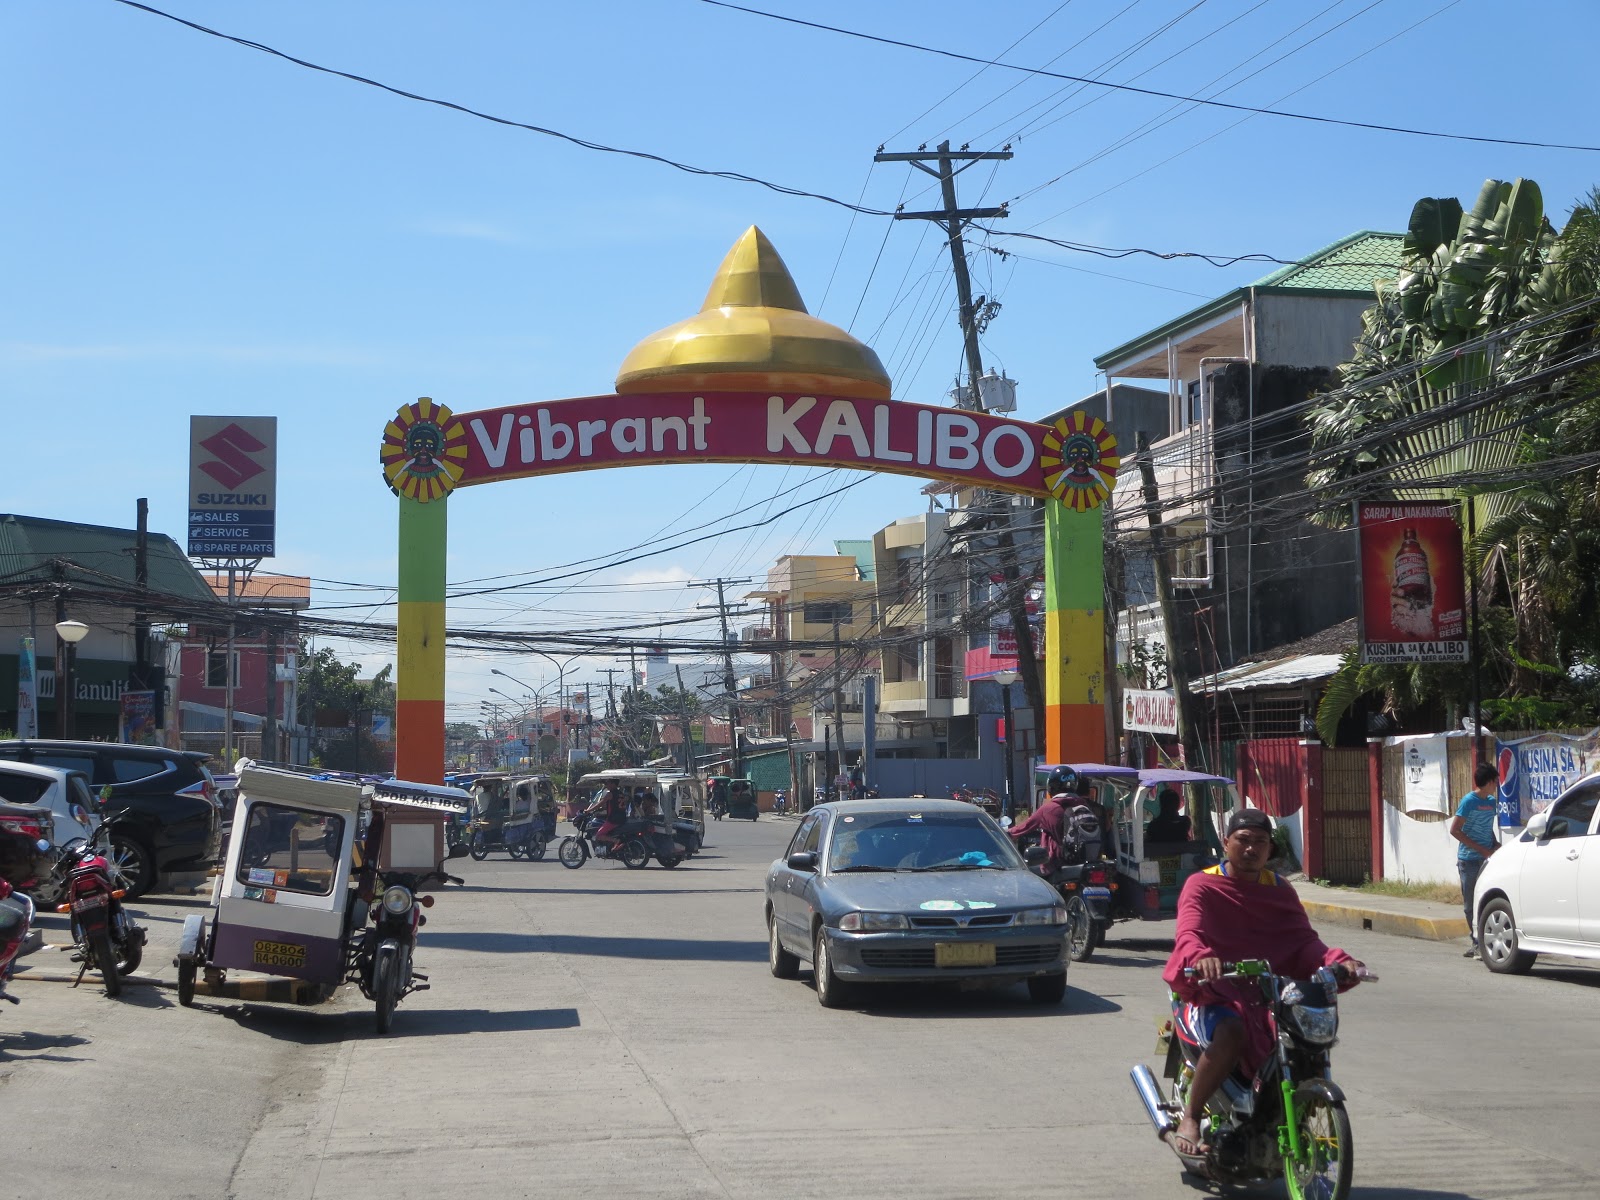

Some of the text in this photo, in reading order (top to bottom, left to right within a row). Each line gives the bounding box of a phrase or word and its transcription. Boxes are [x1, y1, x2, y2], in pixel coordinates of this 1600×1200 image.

[469, 396, 1035, 477] Vibrant KALIBO
[197, 493, 267, 505] SUZUKI
[204, 513, 240, 522] SALES
[1364, 508, 1390, 519] SARAP
[1392, 507, 1403, 518] NA
[204, 528, 249, 537] SERVICE
[203, 543, 273, 552] SPARE PARTS
[1439, 627, 1462, 638] BEER
[1366, 642, 1464, 655] KUSINA SA KALIBO
[1520, 747, 1575, 774] KUSINA SA
[1529, 775, 1567, 800] KALIBO
[381, 791, 408, 803] POB
[411, 794, 461, 810] KALIBO
[255, 941, 305, 956] 062804
[255, 952, 303, 968] R4-0600
